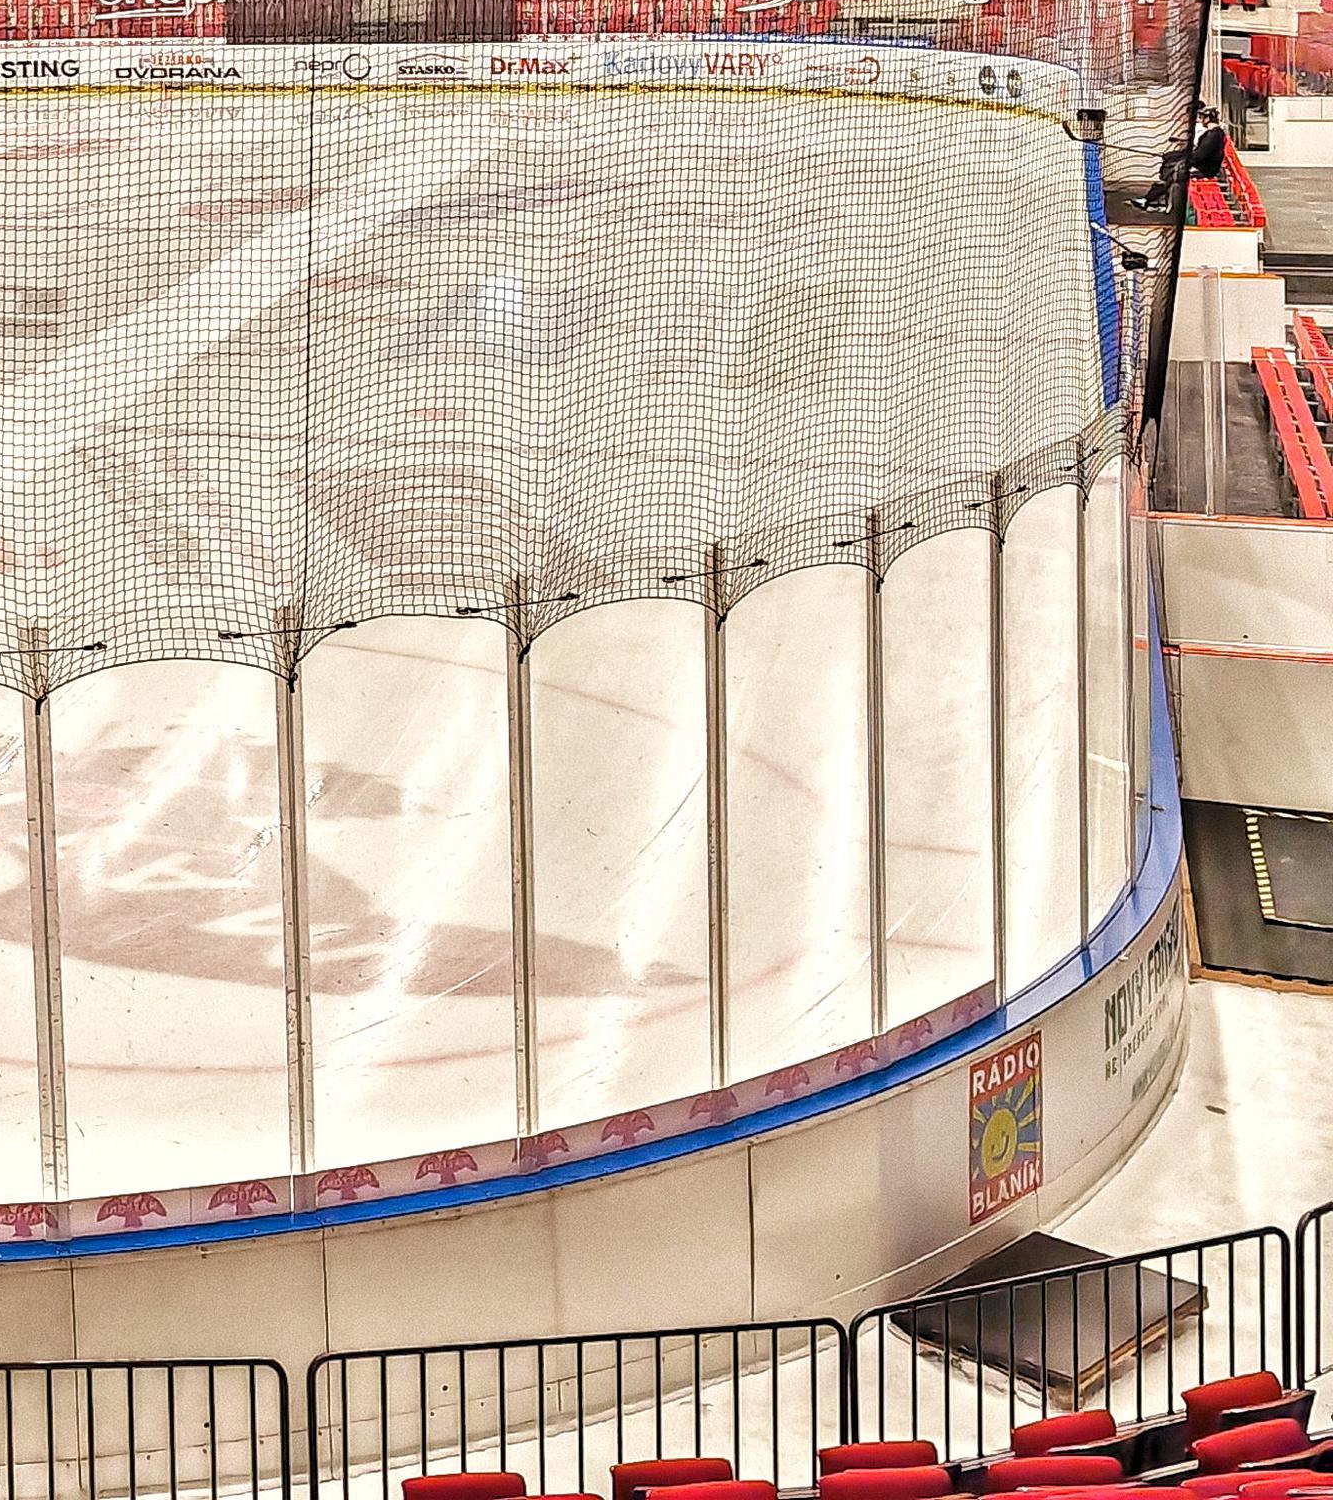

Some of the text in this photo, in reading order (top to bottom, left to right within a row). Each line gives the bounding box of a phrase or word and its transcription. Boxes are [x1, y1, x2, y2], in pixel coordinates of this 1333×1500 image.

[115, 67, 242, 79] DVORANA
[971, 1037, 1041, 1100] RÁDIO
[971, 1157, 1041, 1220] BLANÍK
